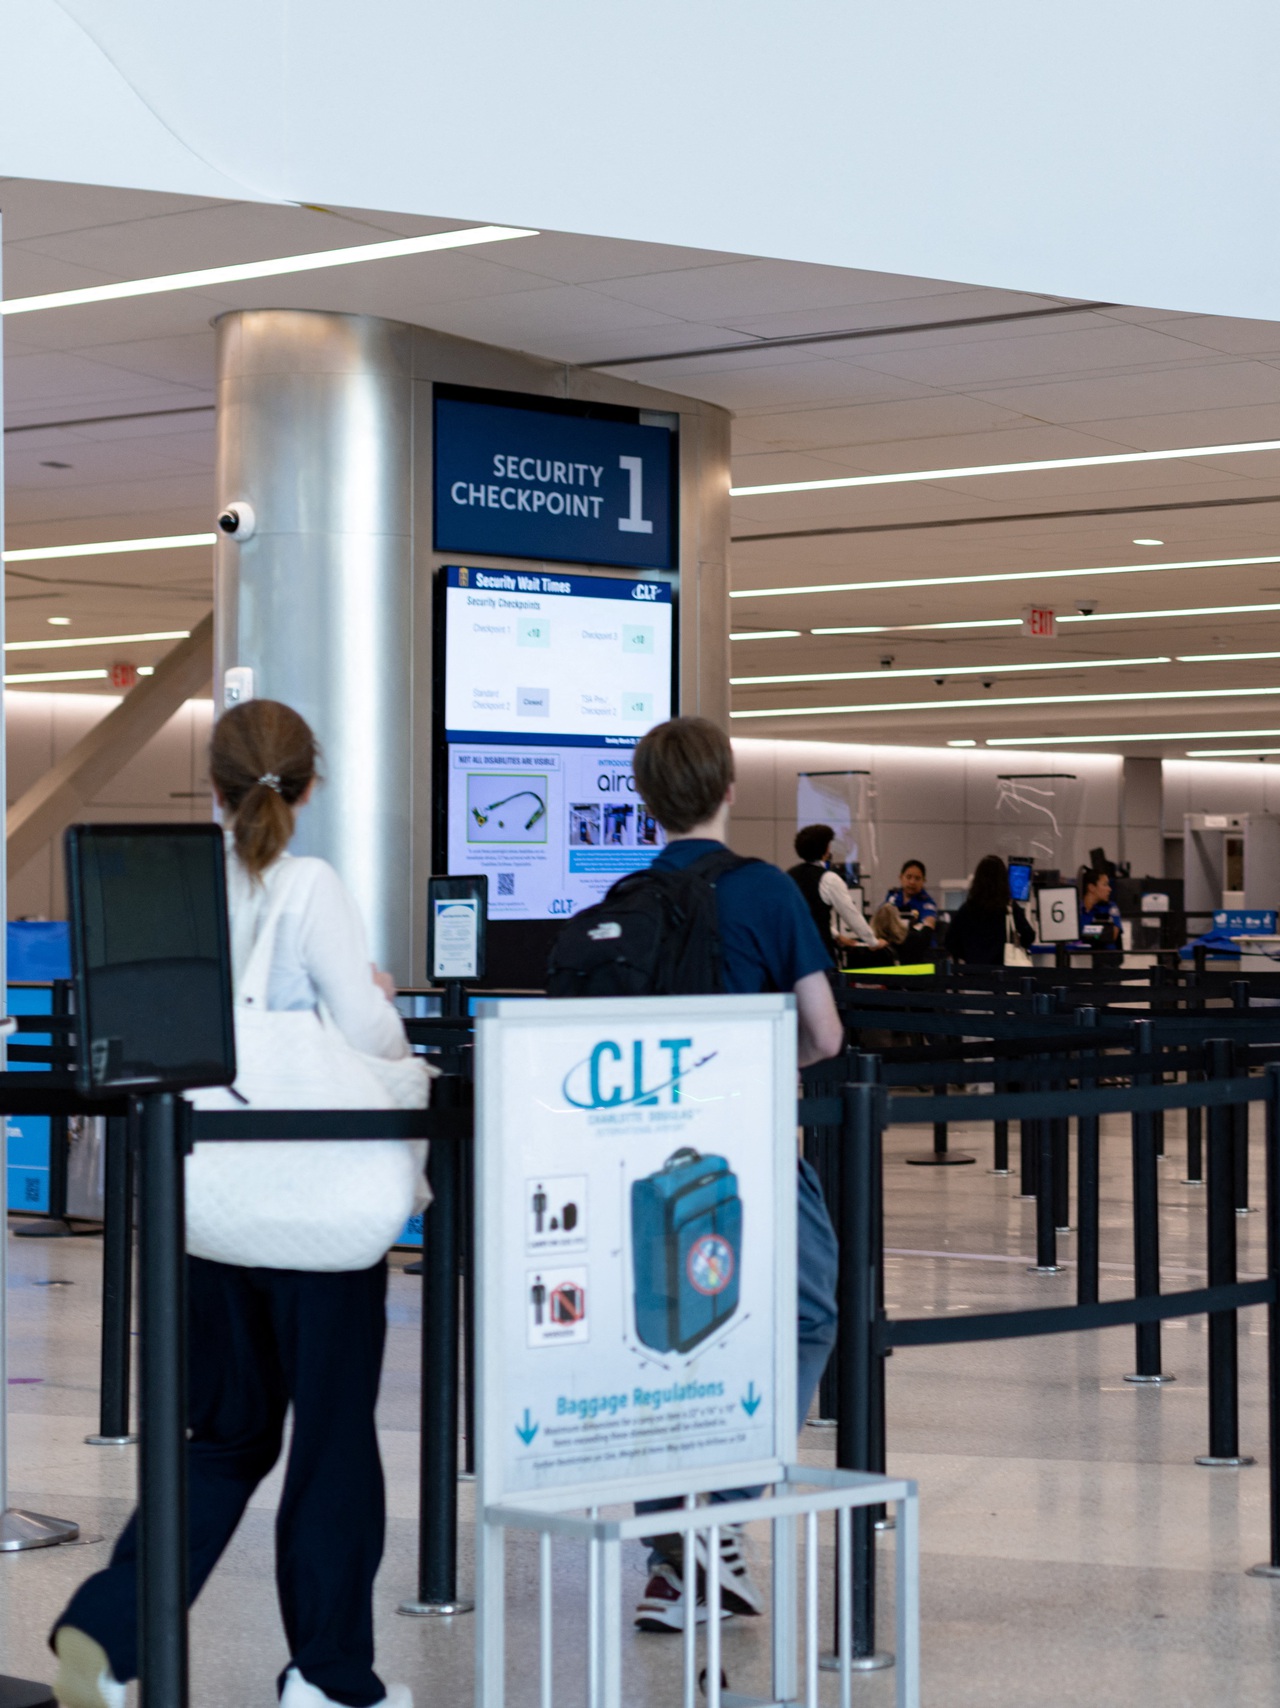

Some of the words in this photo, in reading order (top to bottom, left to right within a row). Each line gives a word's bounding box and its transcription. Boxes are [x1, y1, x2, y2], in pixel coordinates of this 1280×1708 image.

[493, 454, 604, 488] SECURITY
[451, 482, 604, 519] CHECKPOINT
[618, 455, 653, 534] 1
[476, 572, 516, 590] Security
[517, 575, 541, 591] Wait
[541, 577, 571, 593] Times
[635, 584, 658, 600] CLT
[467, 596, 496, 609] Security
[498, 598, 541, 610] Checkpoints
[458, 756, 471, 764] NOT
[473, 756, 483, 764] ALL
[484, 756, 520, 765] DISABILITIES
[522, 757, 533, 765] ARE
[534, 757, 555, 766] VISIBLE
[550, 899, 573, 914] CLT
[1051, 900, 1065, 923] 6
[589, 1037, 693, 1109] CLT
[556, 1393, 627, 1420] Baggage
[633, 1380, 725, 1411] Regulations
